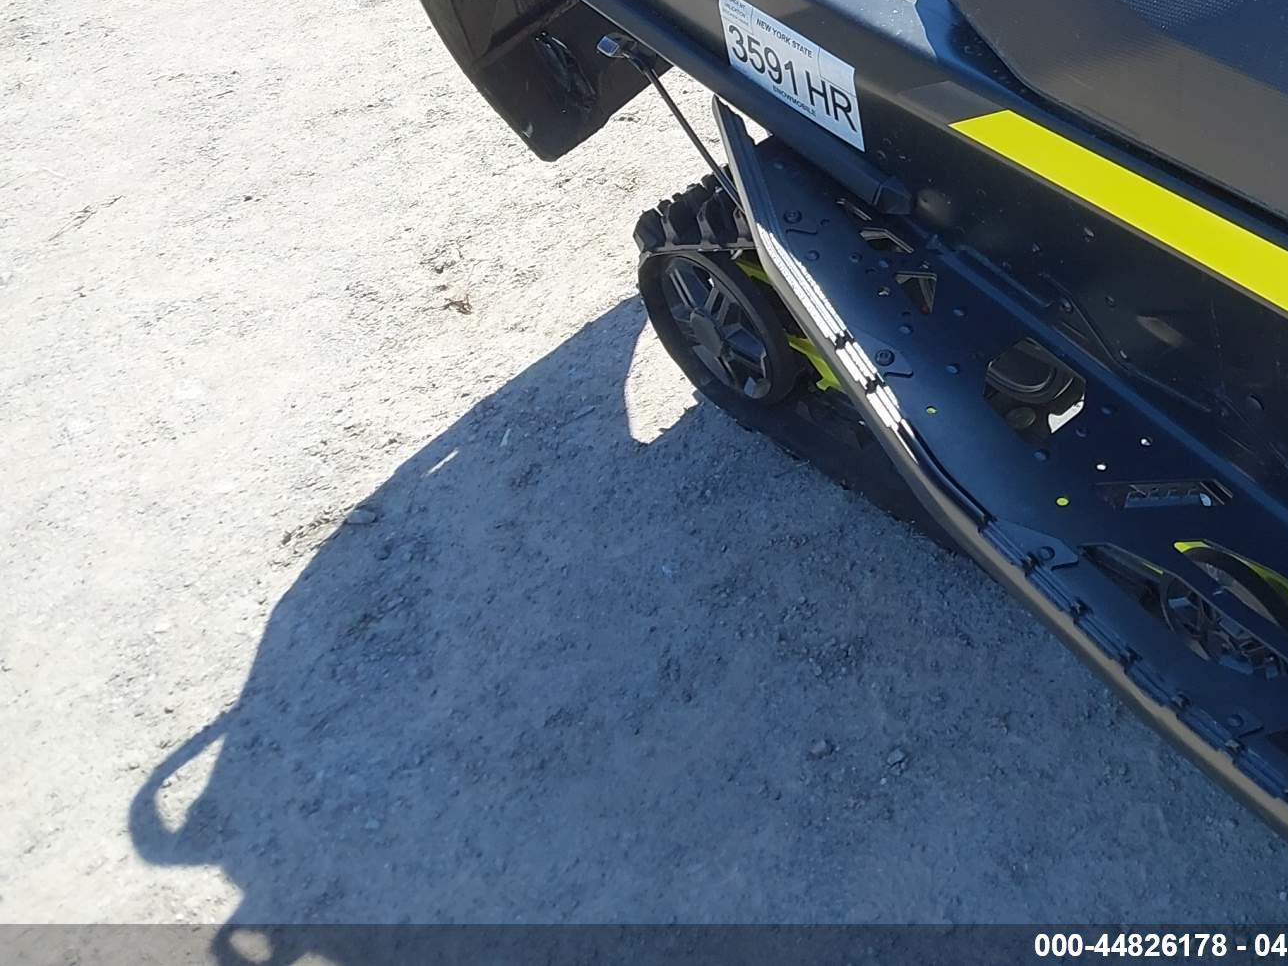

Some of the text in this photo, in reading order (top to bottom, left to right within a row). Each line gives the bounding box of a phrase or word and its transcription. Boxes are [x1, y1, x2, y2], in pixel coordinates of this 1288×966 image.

[756, 18, 812, 58] NEW YORK STATE
[729, 26, 856, 131] 3591 HR
